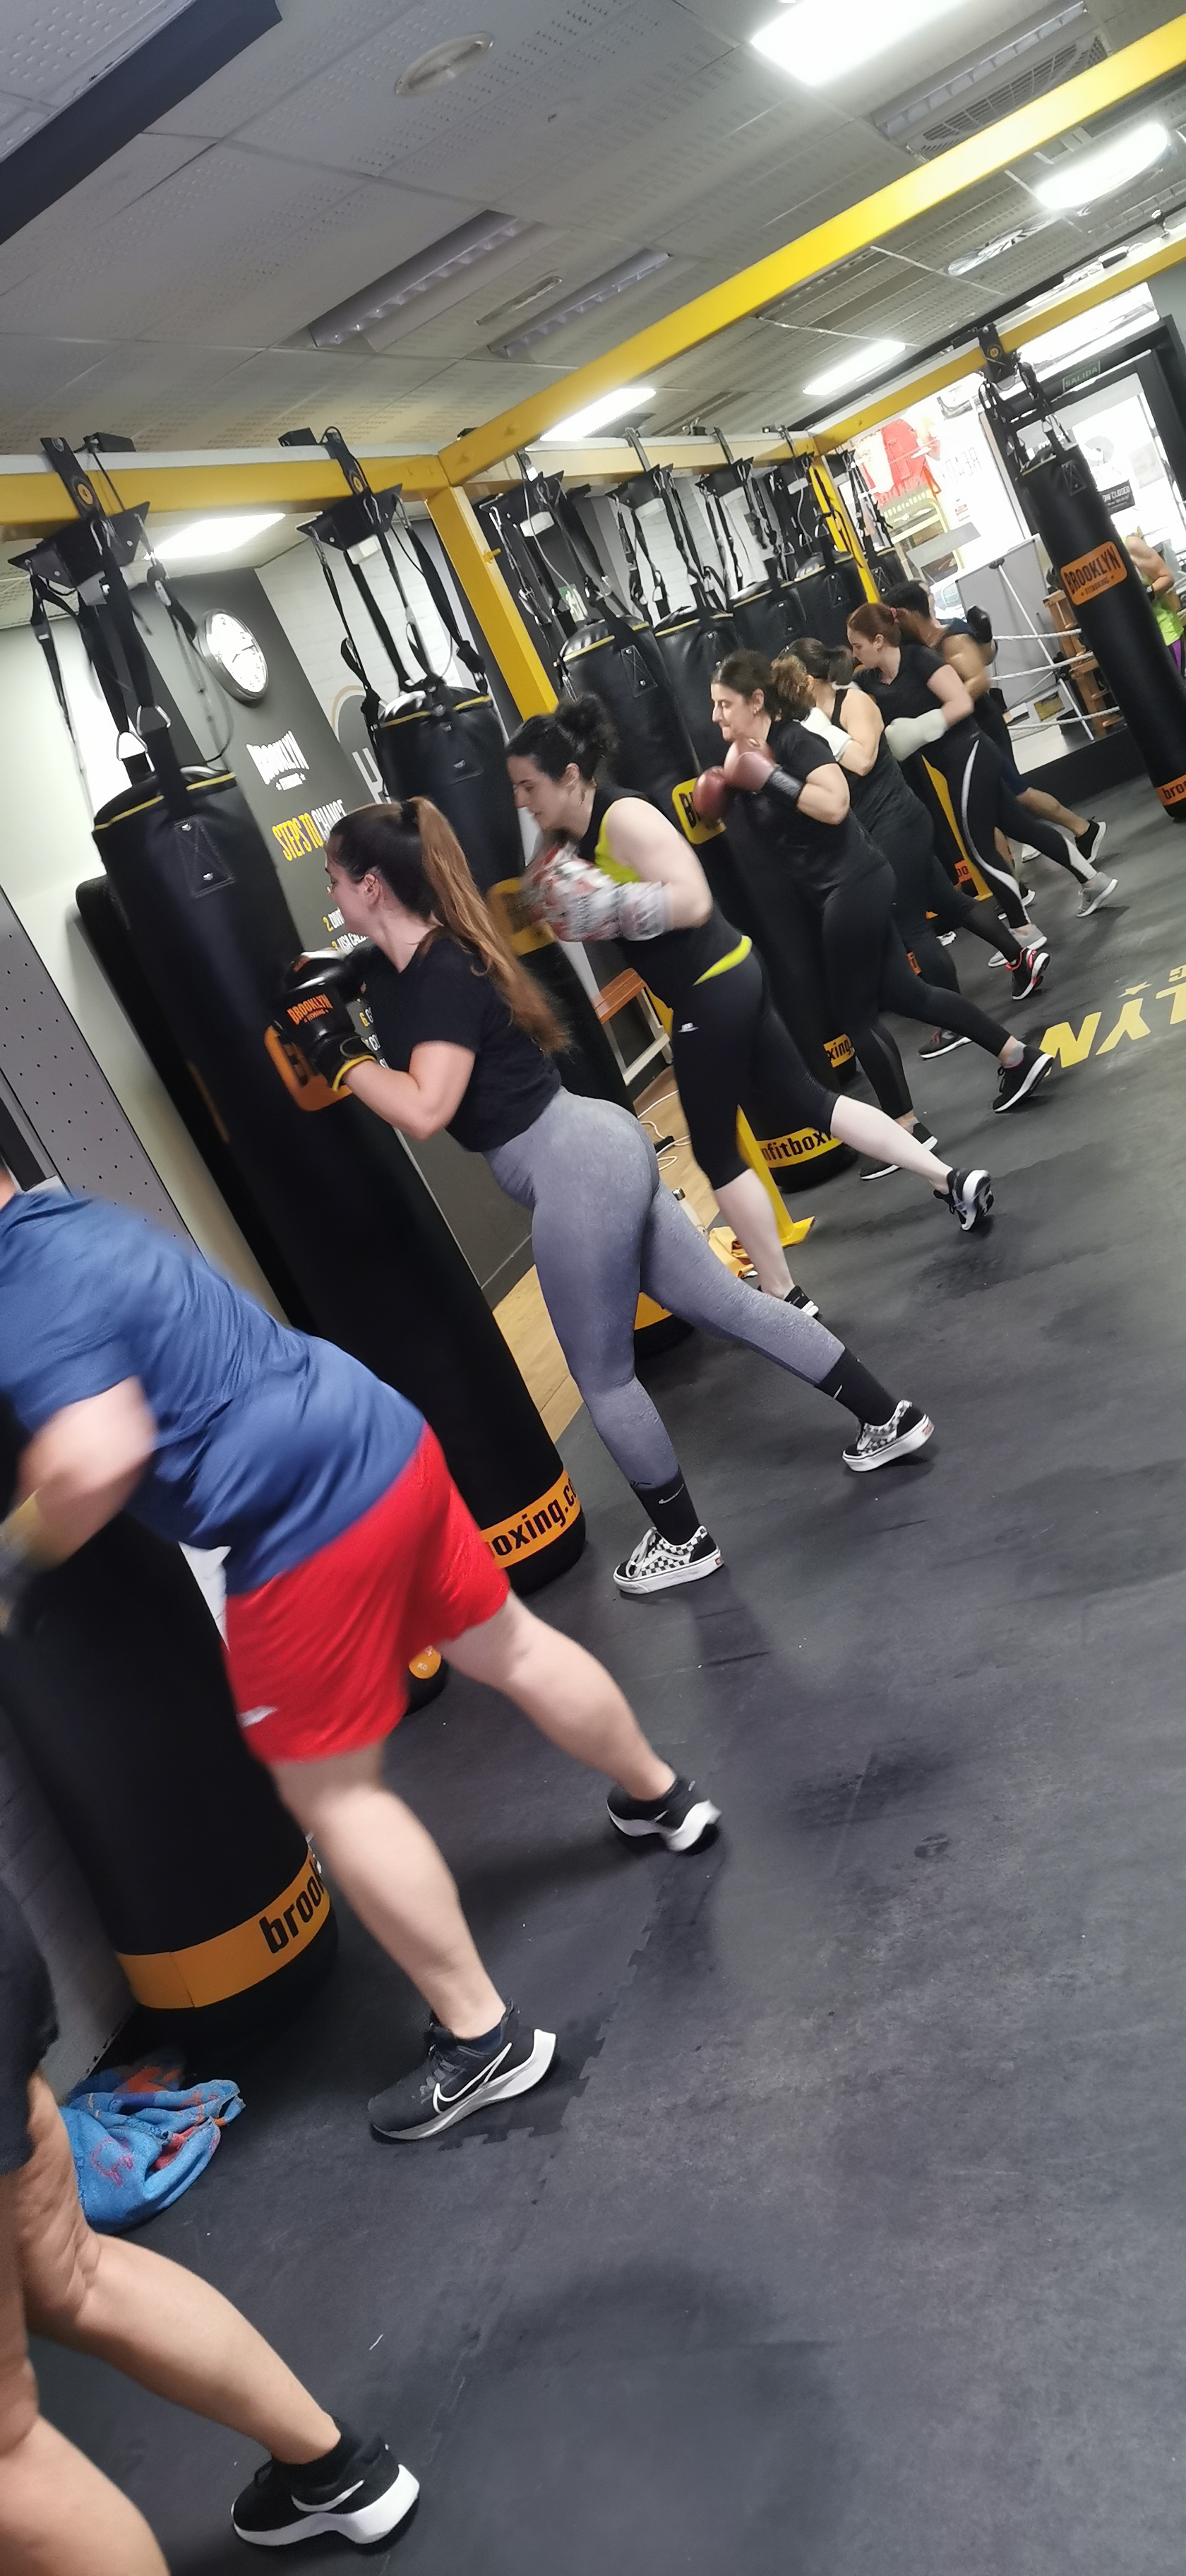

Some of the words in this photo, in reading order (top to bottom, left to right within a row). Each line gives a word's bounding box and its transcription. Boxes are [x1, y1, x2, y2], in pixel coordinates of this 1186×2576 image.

[1062, 544, 1121, 595] BROOKLYN
[272, 817, 313, 862] STEPS
[299, 812, 324, 849] TO
[286, 993, 334, 1026] BROOKLYN
